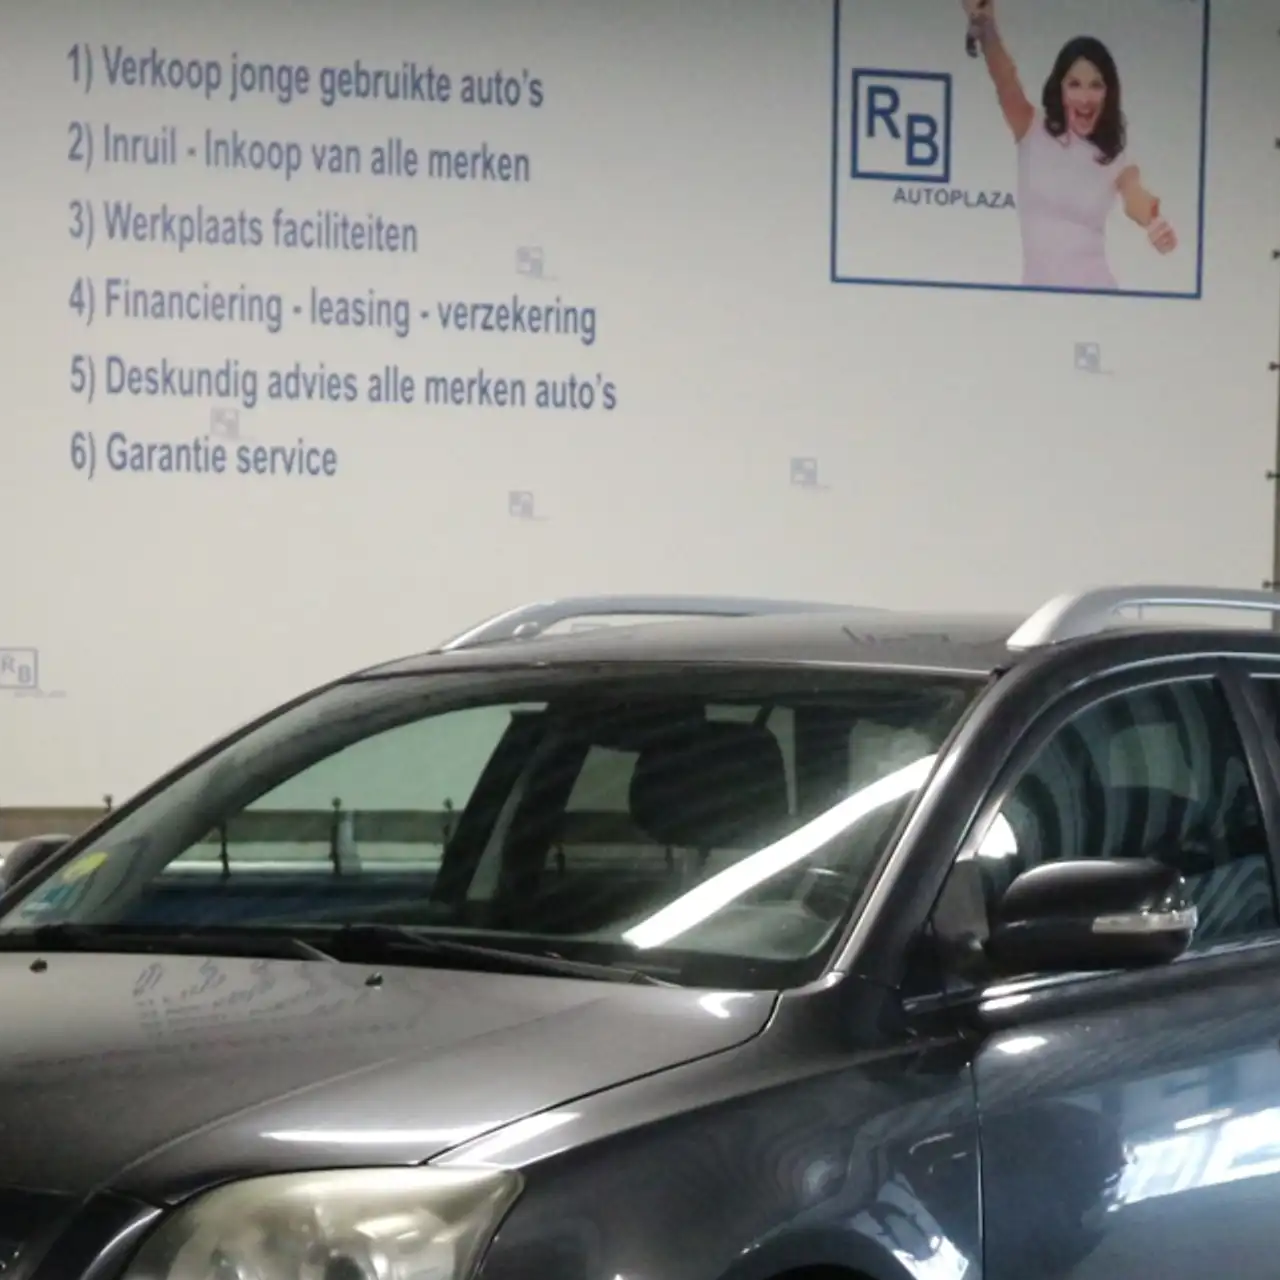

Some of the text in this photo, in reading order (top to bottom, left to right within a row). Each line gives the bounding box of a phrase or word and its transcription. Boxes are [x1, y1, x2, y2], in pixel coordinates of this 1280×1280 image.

[68, 44, 544, 108] 1) Verkoop jonge gebruikte auto's
[68, 121, 93, 171] 2)
[104, 123, 176, 165] Inruil
[205, 128, 302, 181] Inkoop
[312, 144, 361, 173] van
[371, 138, 418, 177] alle
[428, 143, 529, 182] merken
[866, 84, 940, 166] RB
[69, 200, 417, 252] 3) Werkplaats faciliteiten
[893, 186, 1017, 209] AUTOPLAZA
[69, 277, 95, 327] 4)
[106, 278, 282, 334] Financiering
[311, 287, 410, 338] leasing
[438, 295, 596, 346] verzekering
[71, 354, 616, 410] 5) Deskundig advies alle merken auto's
[71, 431, 337, 480] 6) Garantie service
